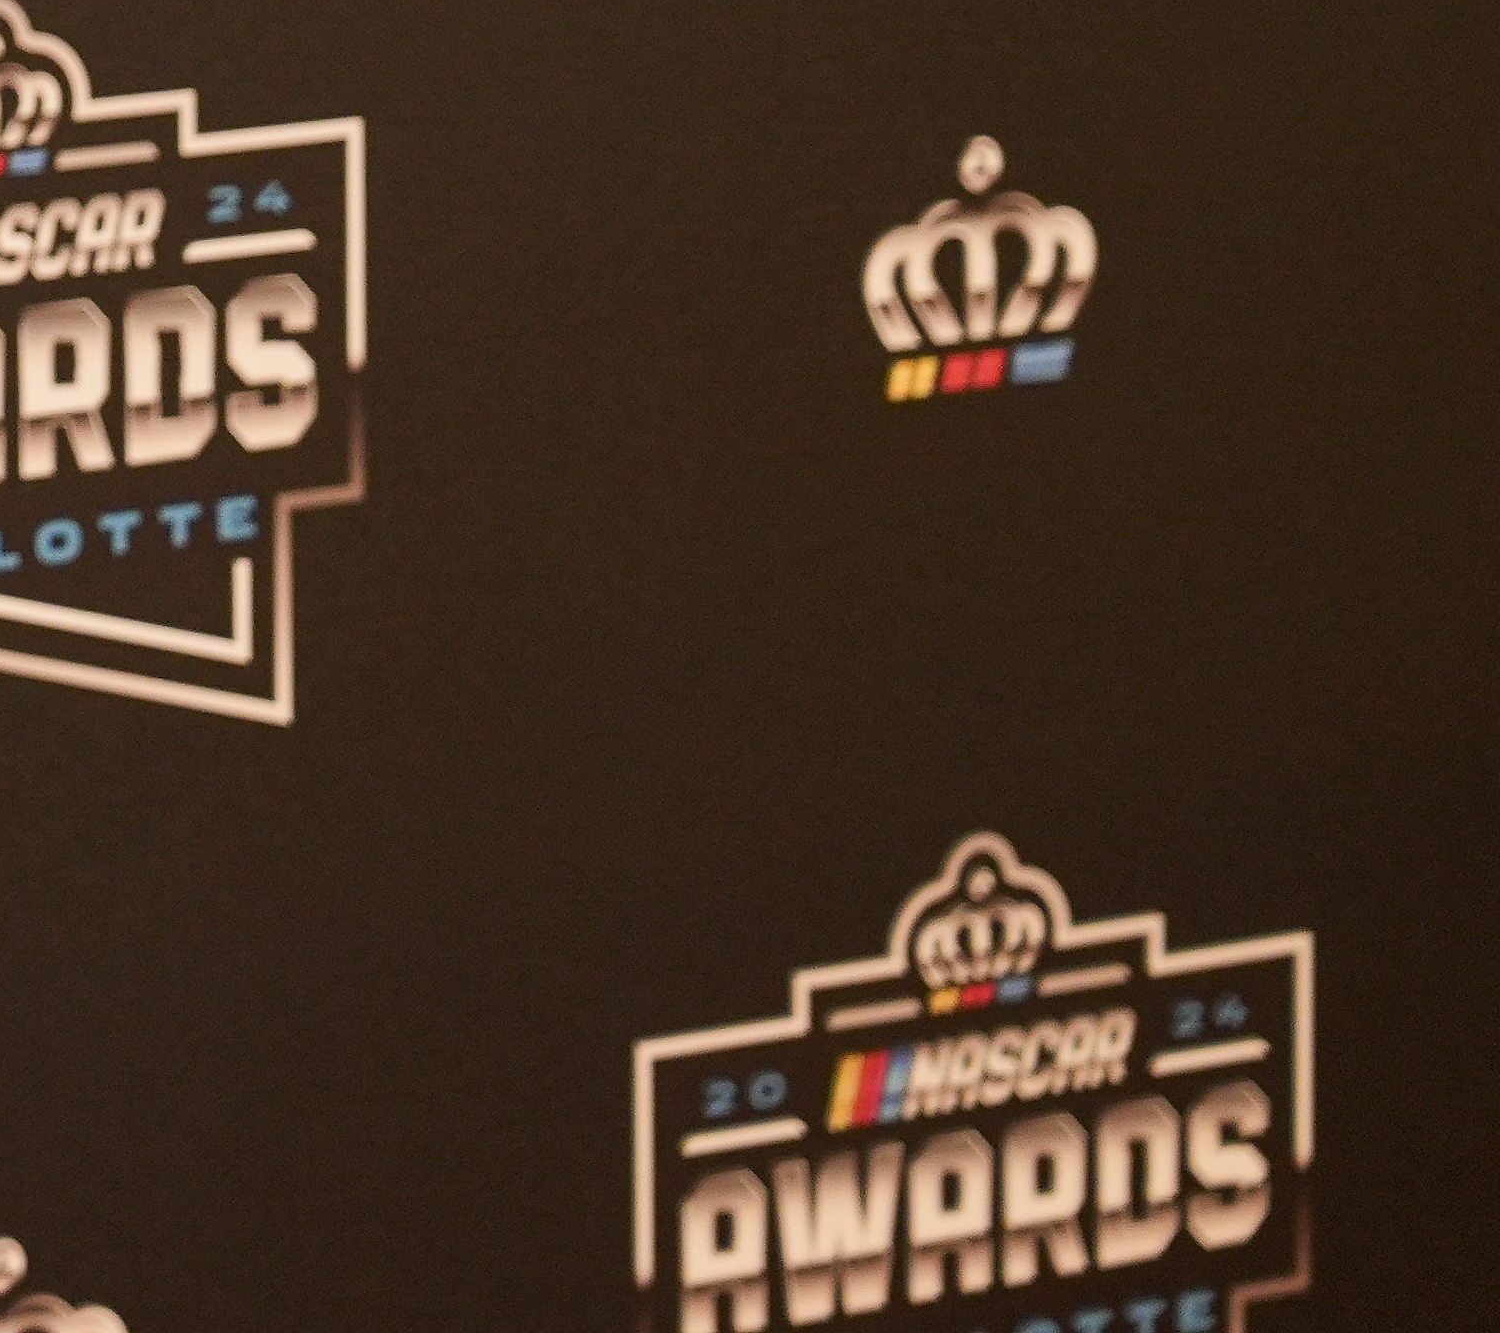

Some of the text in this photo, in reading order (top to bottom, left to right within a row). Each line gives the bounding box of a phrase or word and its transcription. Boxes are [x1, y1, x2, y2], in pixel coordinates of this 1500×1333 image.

[208, 182, 293, 223] 24
[703, 994, 1251, 1121] 20 NASCAR 24
[680, 1078, 1273, 1333] AWARDS
